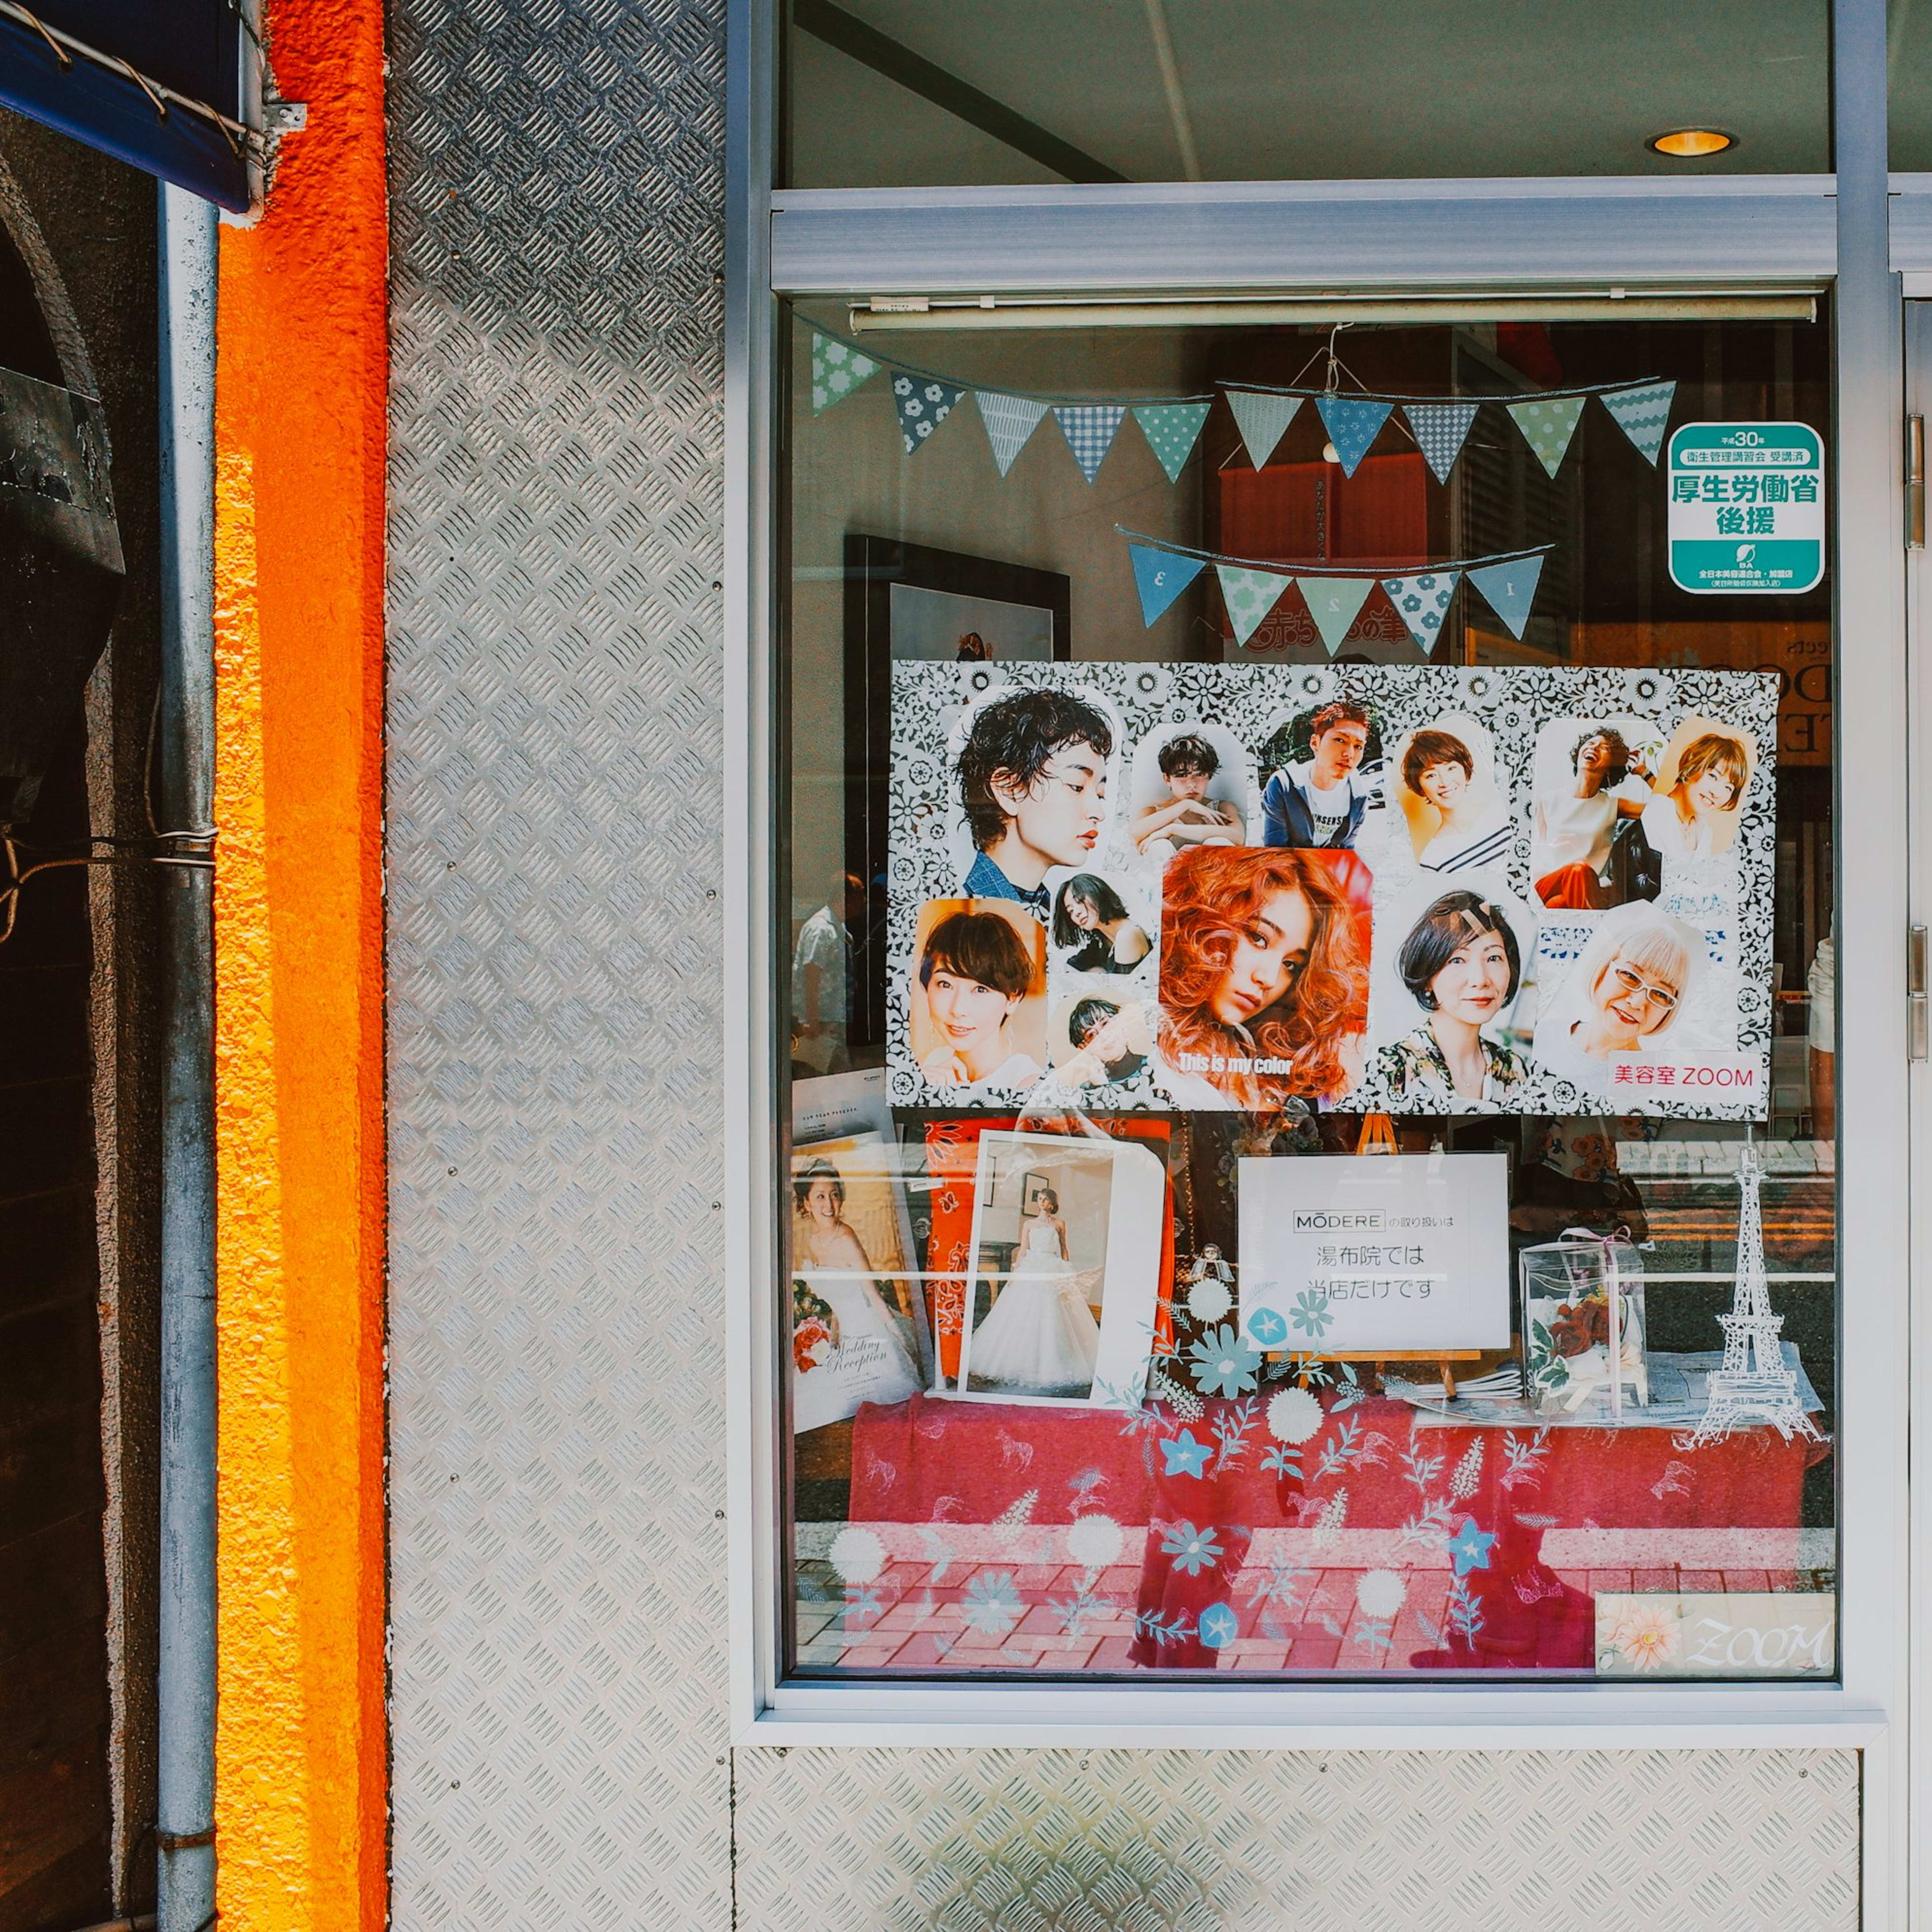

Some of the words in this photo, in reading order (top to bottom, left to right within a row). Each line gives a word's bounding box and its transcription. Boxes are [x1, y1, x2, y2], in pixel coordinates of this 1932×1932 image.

[1687, 451, 1765, 462] 衛生管理講習会
[1770, 451, 1804, 462] 受講済
[1672, 474, 1819, 503] 厚生労働省
[1716, 506, 1775, 534] 後援
[1179, 1053, 1209, 1072] This
[1212, 1054, 1225, 1072] is
[1228, 1058, 1252, 1075] my
[1254, 1056, 1293, 1075] color
[1614, 1065, 1675, 1085] 美容室
[1682, 1067, 1753, 1087] ZOOM
[1389, 1217, 1454, 1228] の取り扱いは
[1316, 1245, 1424, 1266] 湯布院では
[1307, 1279, 1435, 1300] 当店だけです
[827, 1339, 880, 1358] Wedding
[827, 1352, 887, 1375] Reception
[1684, 1618, 1832, 1668] ZOOM
